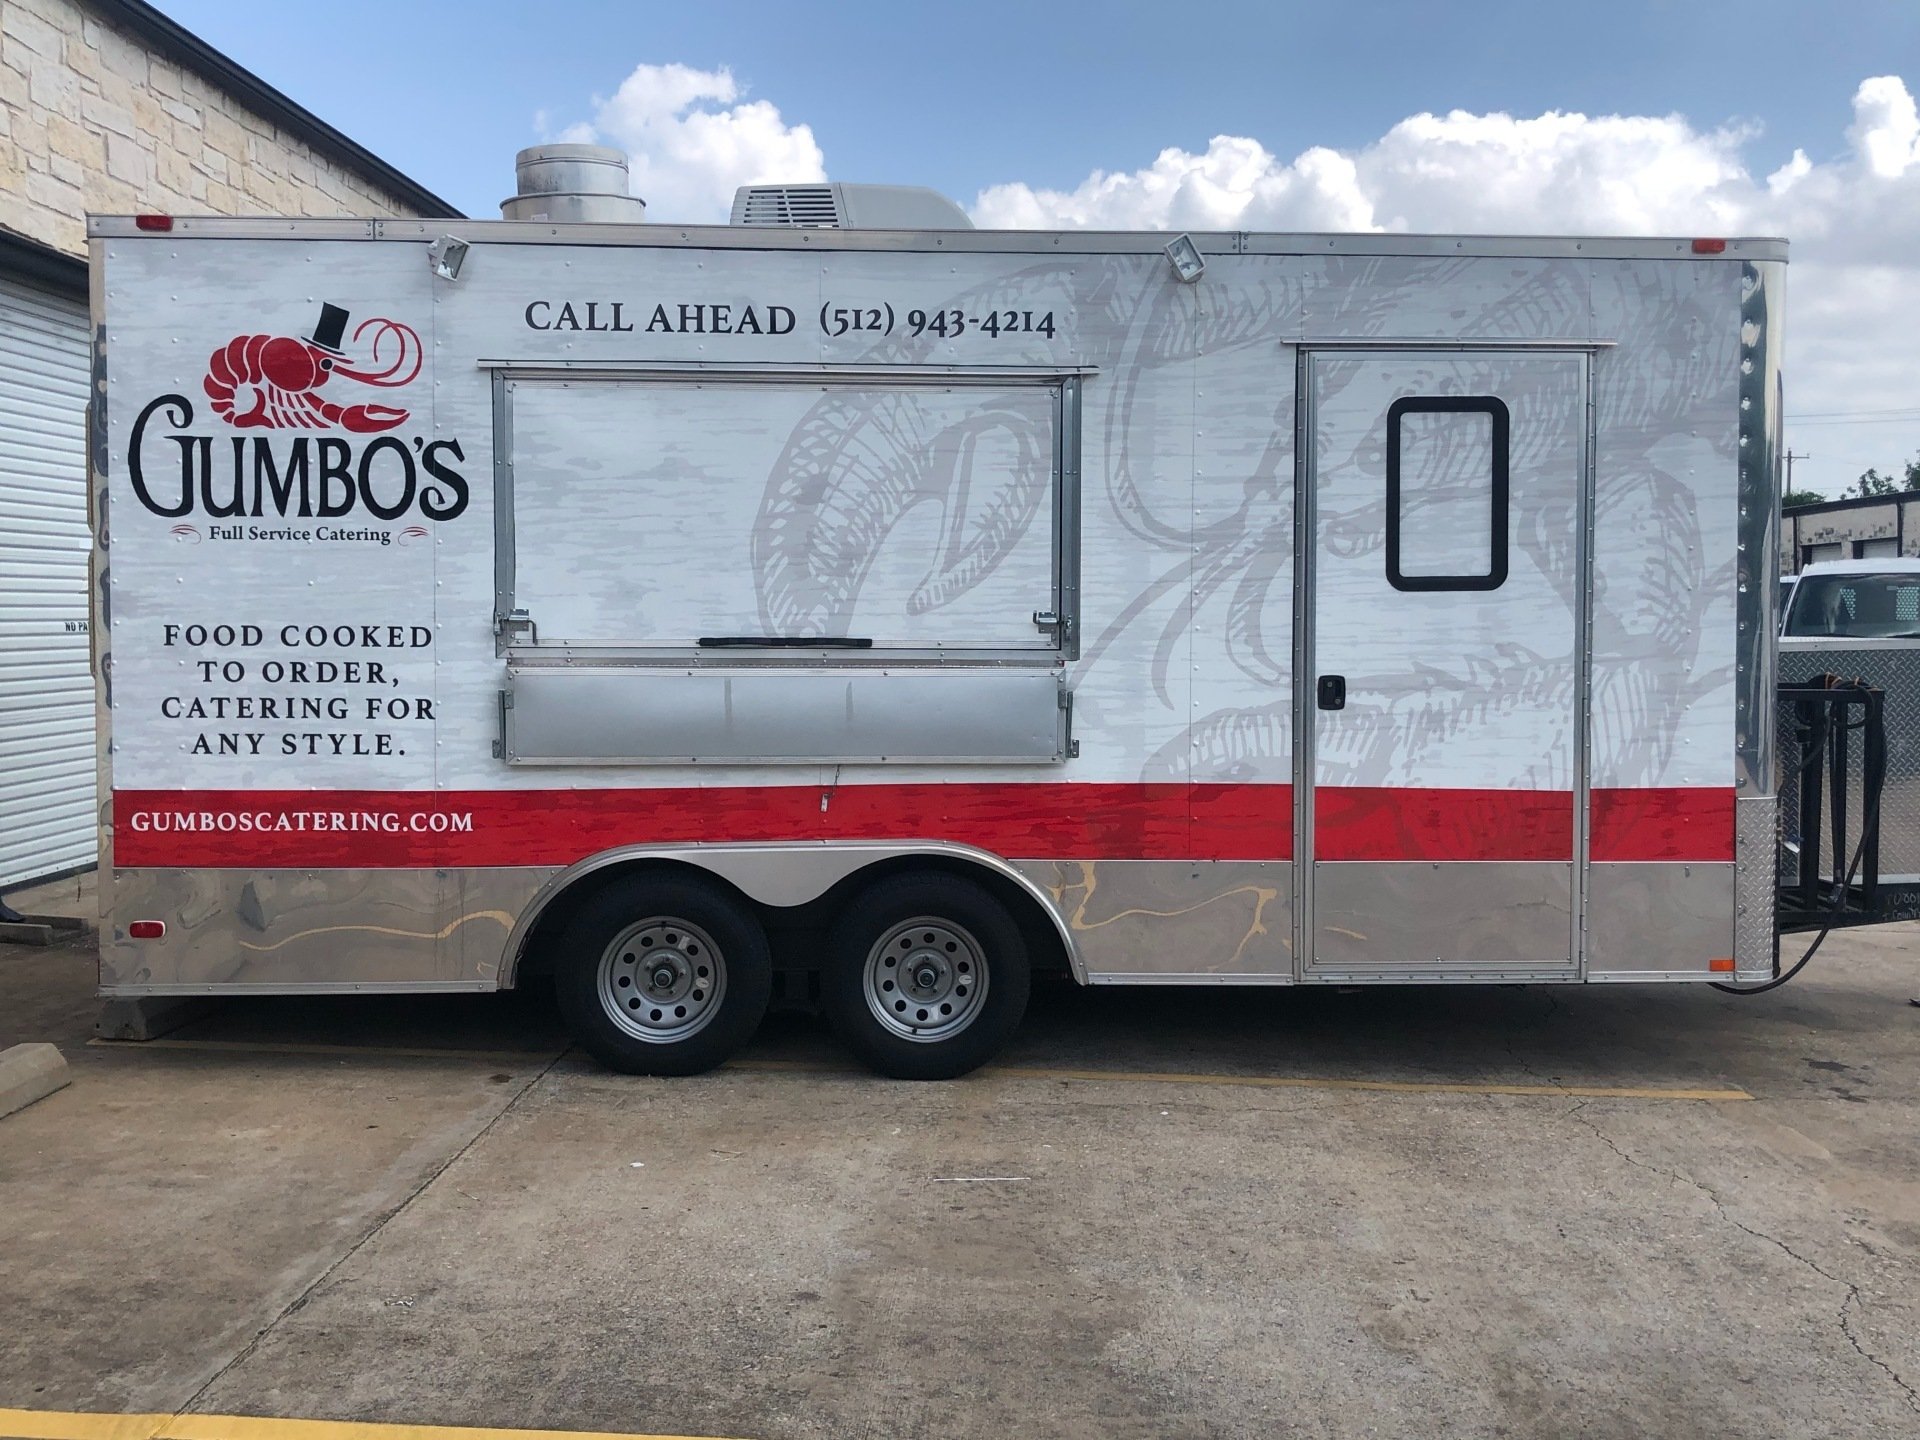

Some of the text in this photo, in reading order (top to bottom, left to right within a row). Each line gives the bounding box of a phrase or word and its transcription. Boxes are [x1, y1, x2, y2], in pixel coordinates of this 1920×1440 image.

[525, 300, 1056, 340] CALL AHEAD (512) 943-4214
[127, 393, 470, 521] GUMBO'S
[209, 525, 392, 545] Full Service Catering
[64, 621, 76, 632] NO
[163, 624, 433, 648] FOOD COOKED
[196, 660, 400, 688] TO ORDER,
[161, 696, 436, 720] CATERING FOR
[190, 733, 406, 756] ANY STYLE.
[131, 812, 474, 833] GUMBOSCATERING.COM
